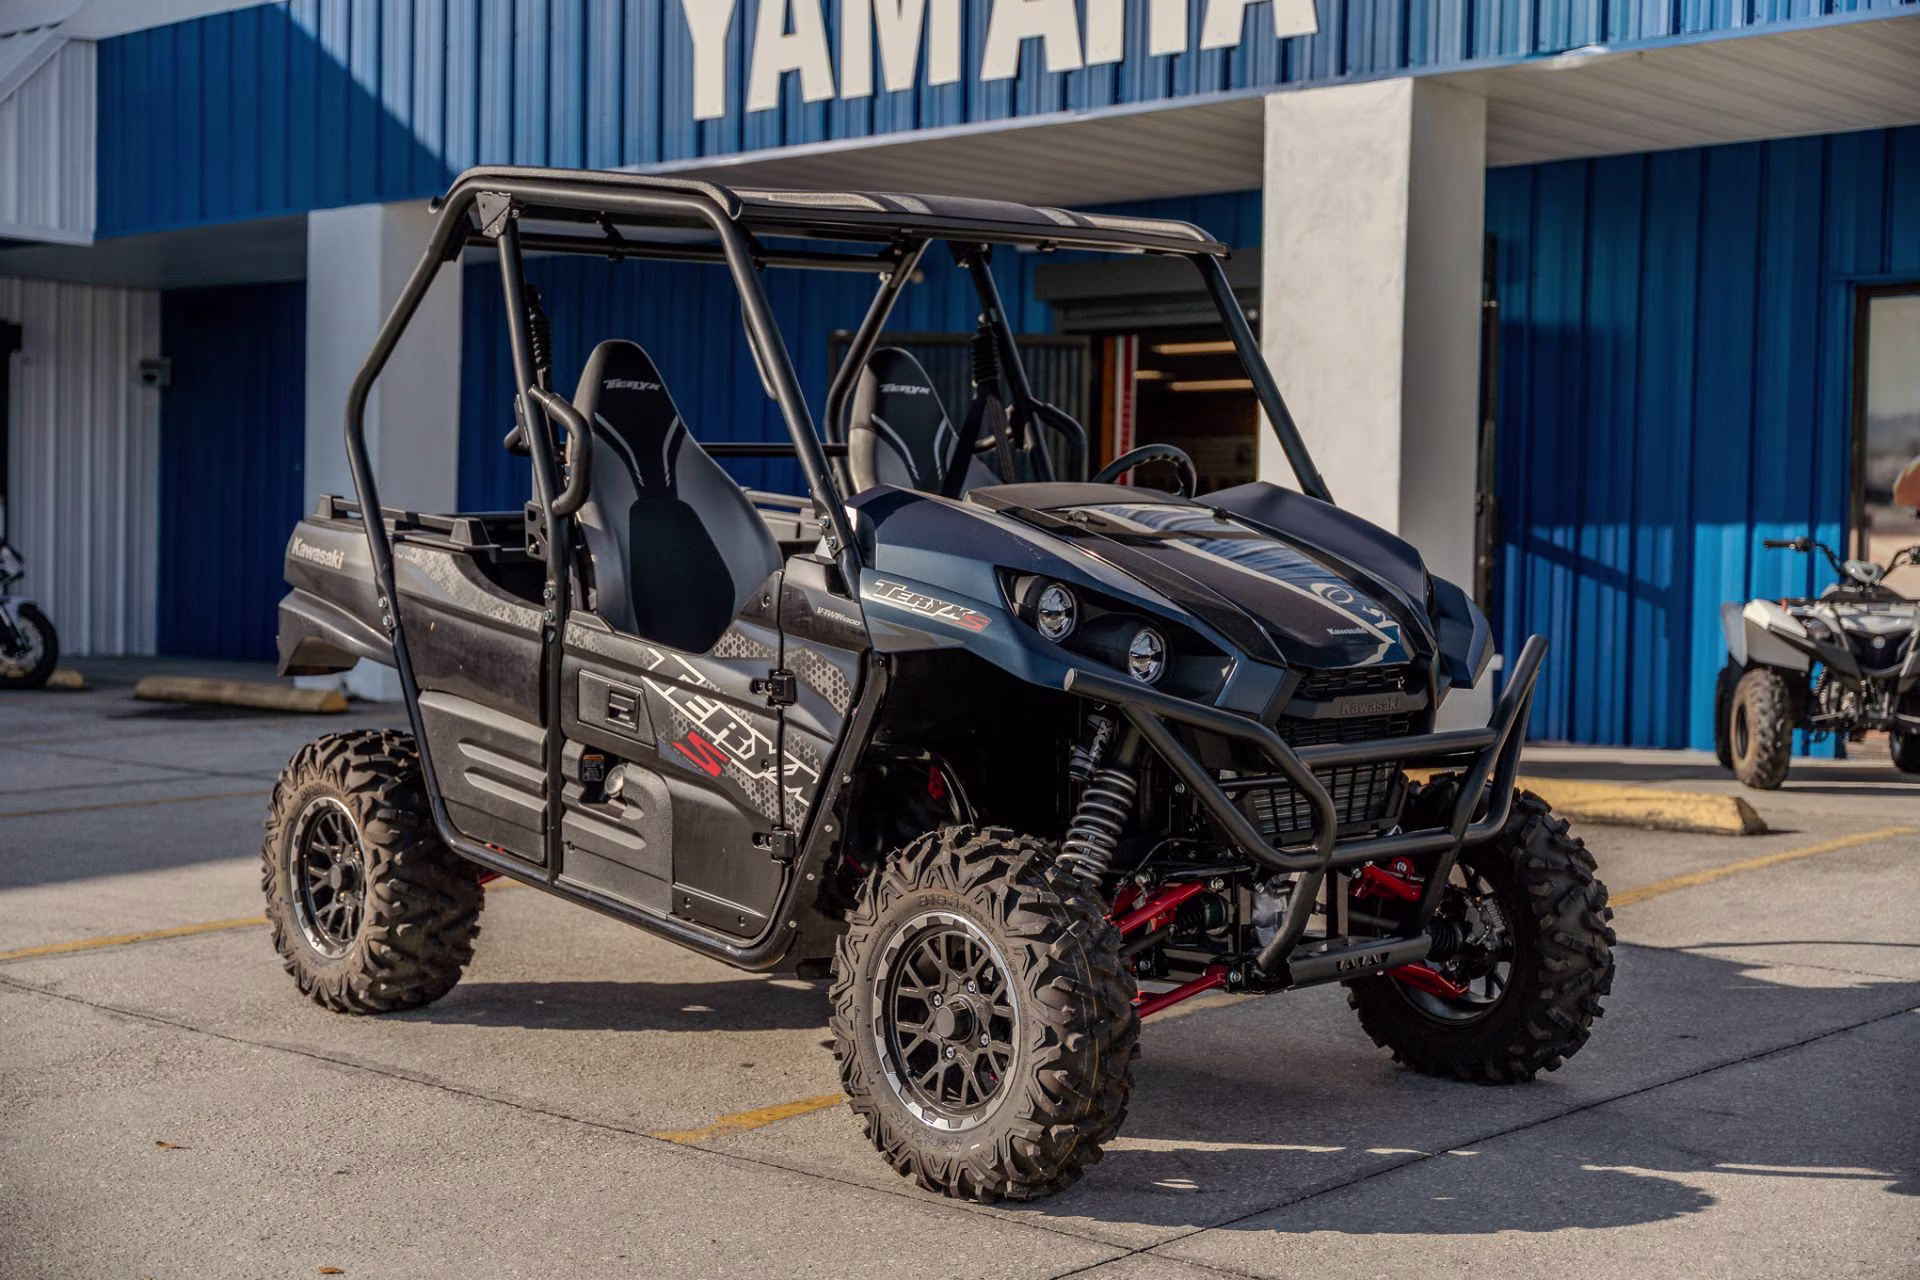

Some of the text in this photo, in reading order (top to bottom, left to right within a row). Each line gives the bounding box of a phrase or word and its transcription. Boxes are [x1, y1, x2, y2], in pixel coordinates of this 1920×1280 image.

[683, 0, 1318, 119] YAM
[291, 537, 346, 570] Kawasaki
[1341, 696, 1401, 715] Kawasaki
